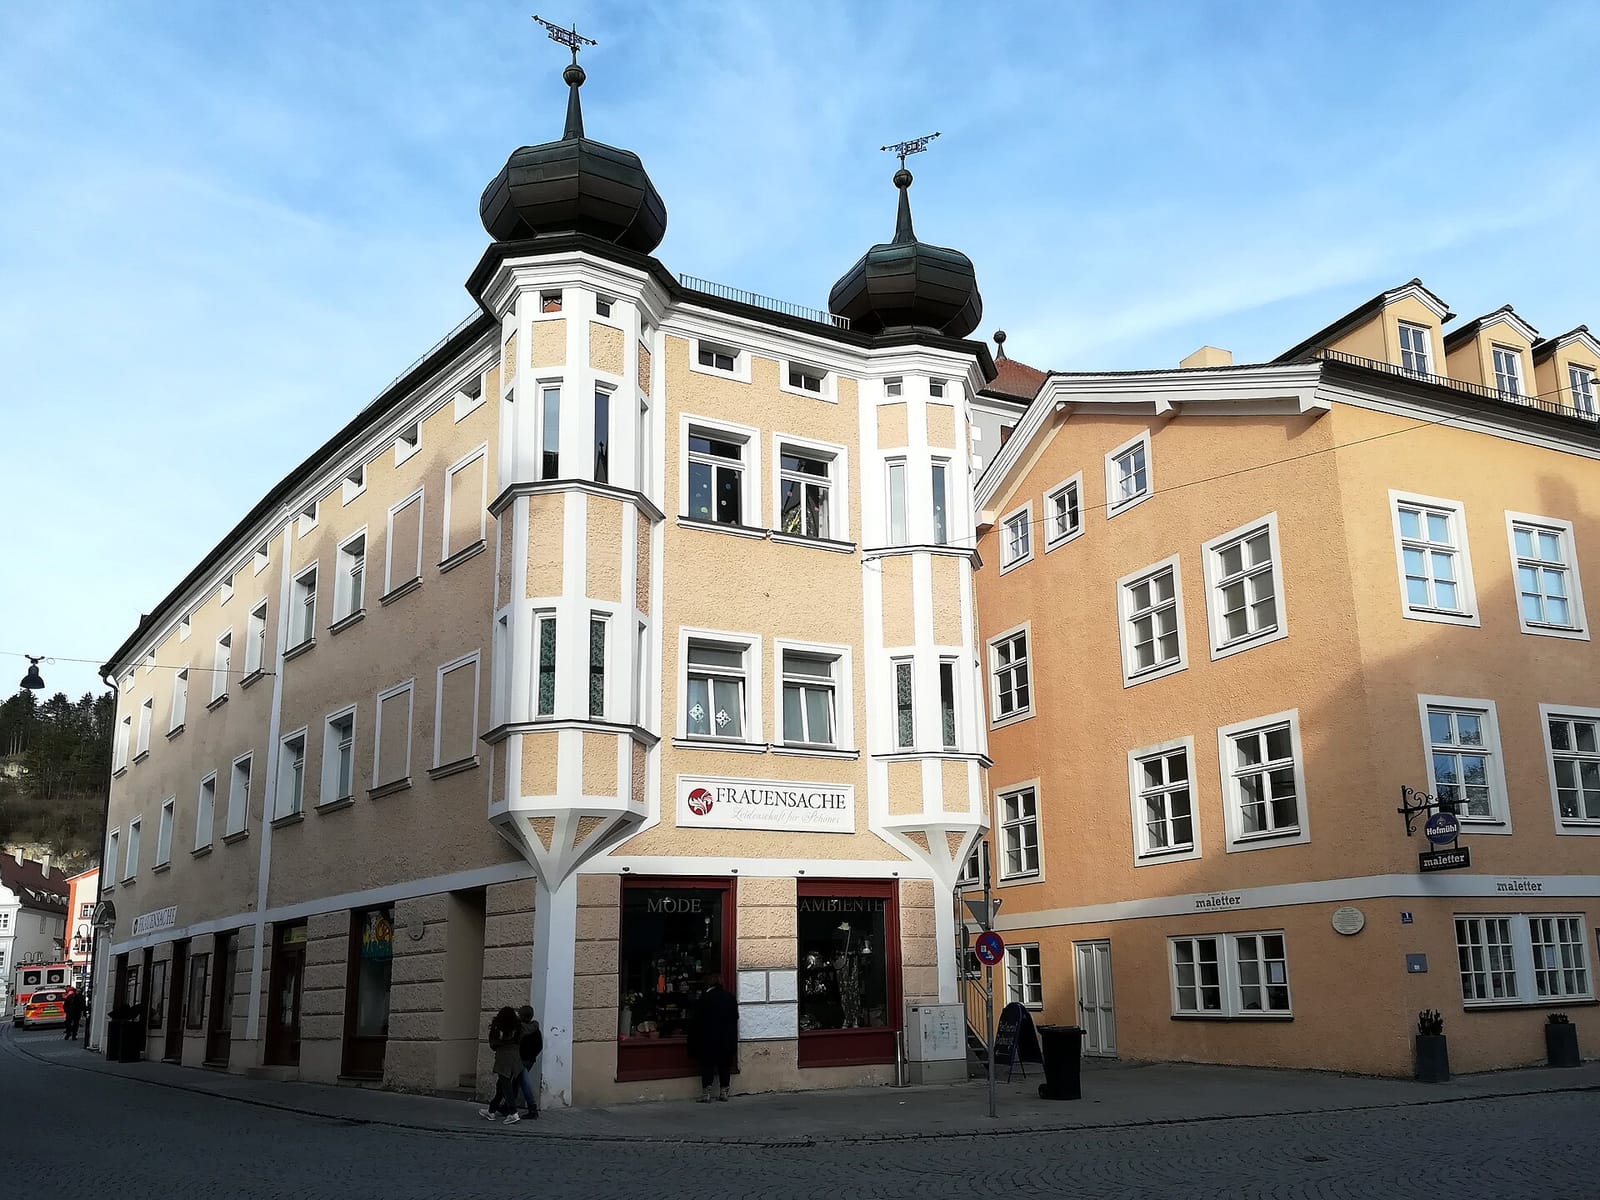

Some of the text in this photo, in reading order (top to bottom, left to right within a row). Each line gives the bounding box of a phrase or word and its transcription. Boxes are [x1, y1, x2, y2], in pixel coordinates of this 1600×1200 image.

[716, 787, 846, 810] FRAUENSACHE
[1426, 824, 1457, 836] Hofmühl
[1423, 855, 1465, 867] maletter
[1496, 880, 1542, 891] maletter
[647, 898, 702, 913] MODE
[799, 898, 884, 912] AMBIENTE
[1195, 895, 1241, 908] maletter
